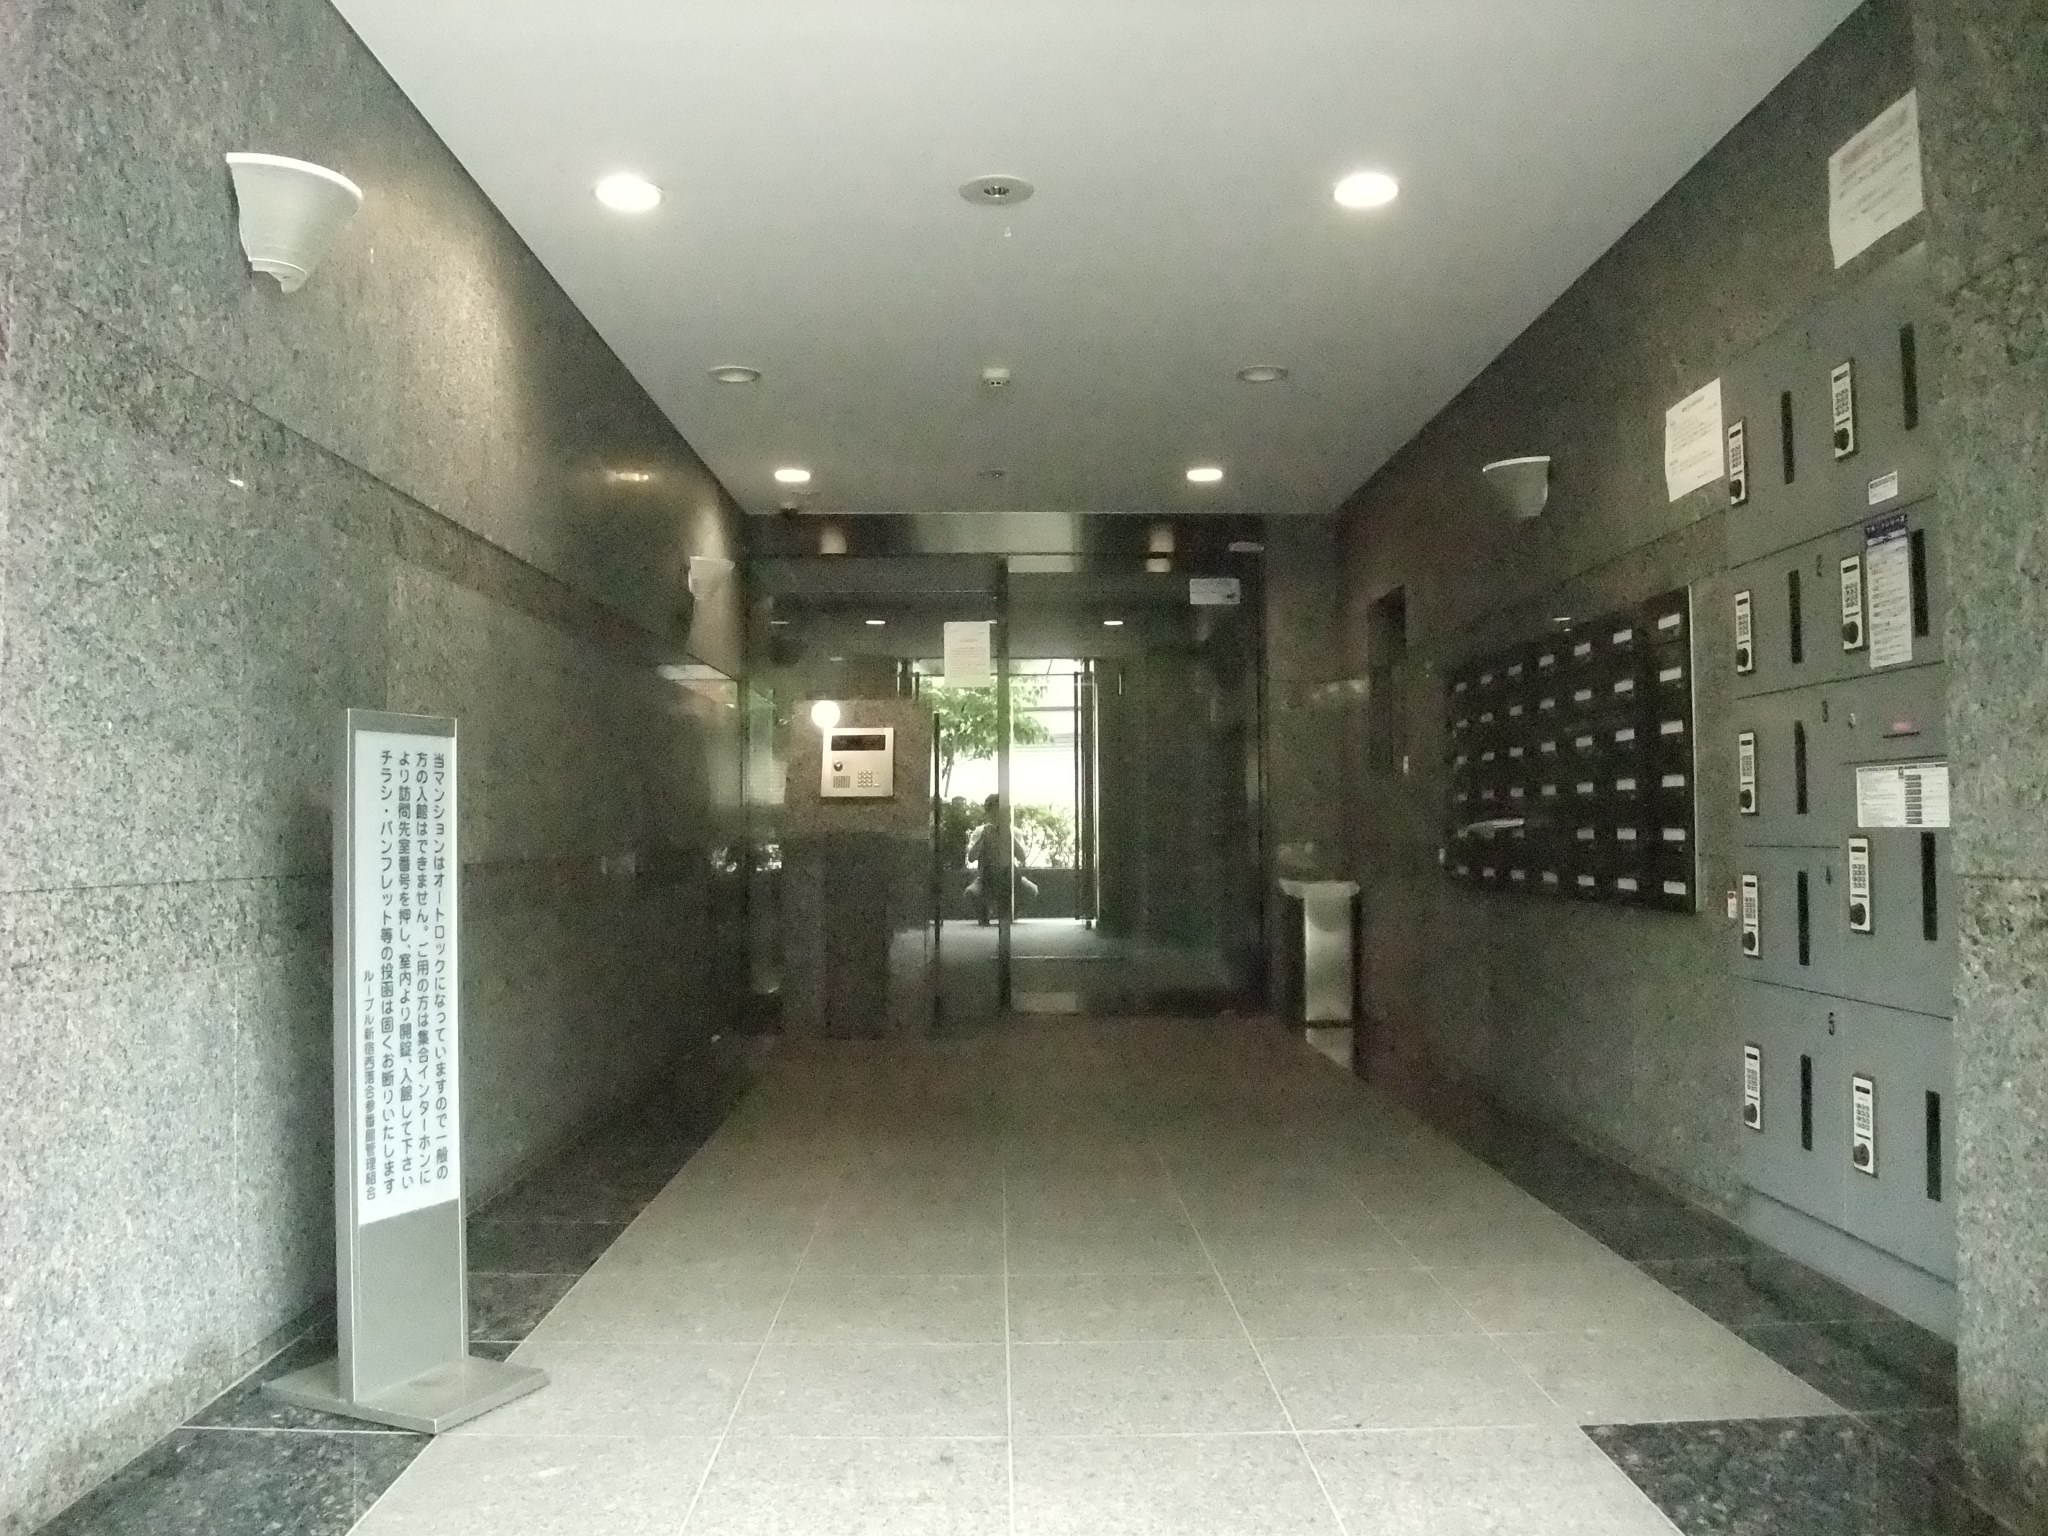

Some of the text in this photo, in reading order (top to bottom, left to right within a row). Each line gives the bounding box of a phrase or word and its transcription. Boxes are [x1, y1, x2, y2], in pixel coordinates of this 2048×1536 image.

[380, 750, 394, 1194] チラシ・パンフレット等の投函は固くお断りいたします
[416, 752, 431, 1184] 方の入館はできません。ご用の方は集合インターホンに
[433, 753, 448, 1180] 当マンションはオートロックになっていますので一般の
